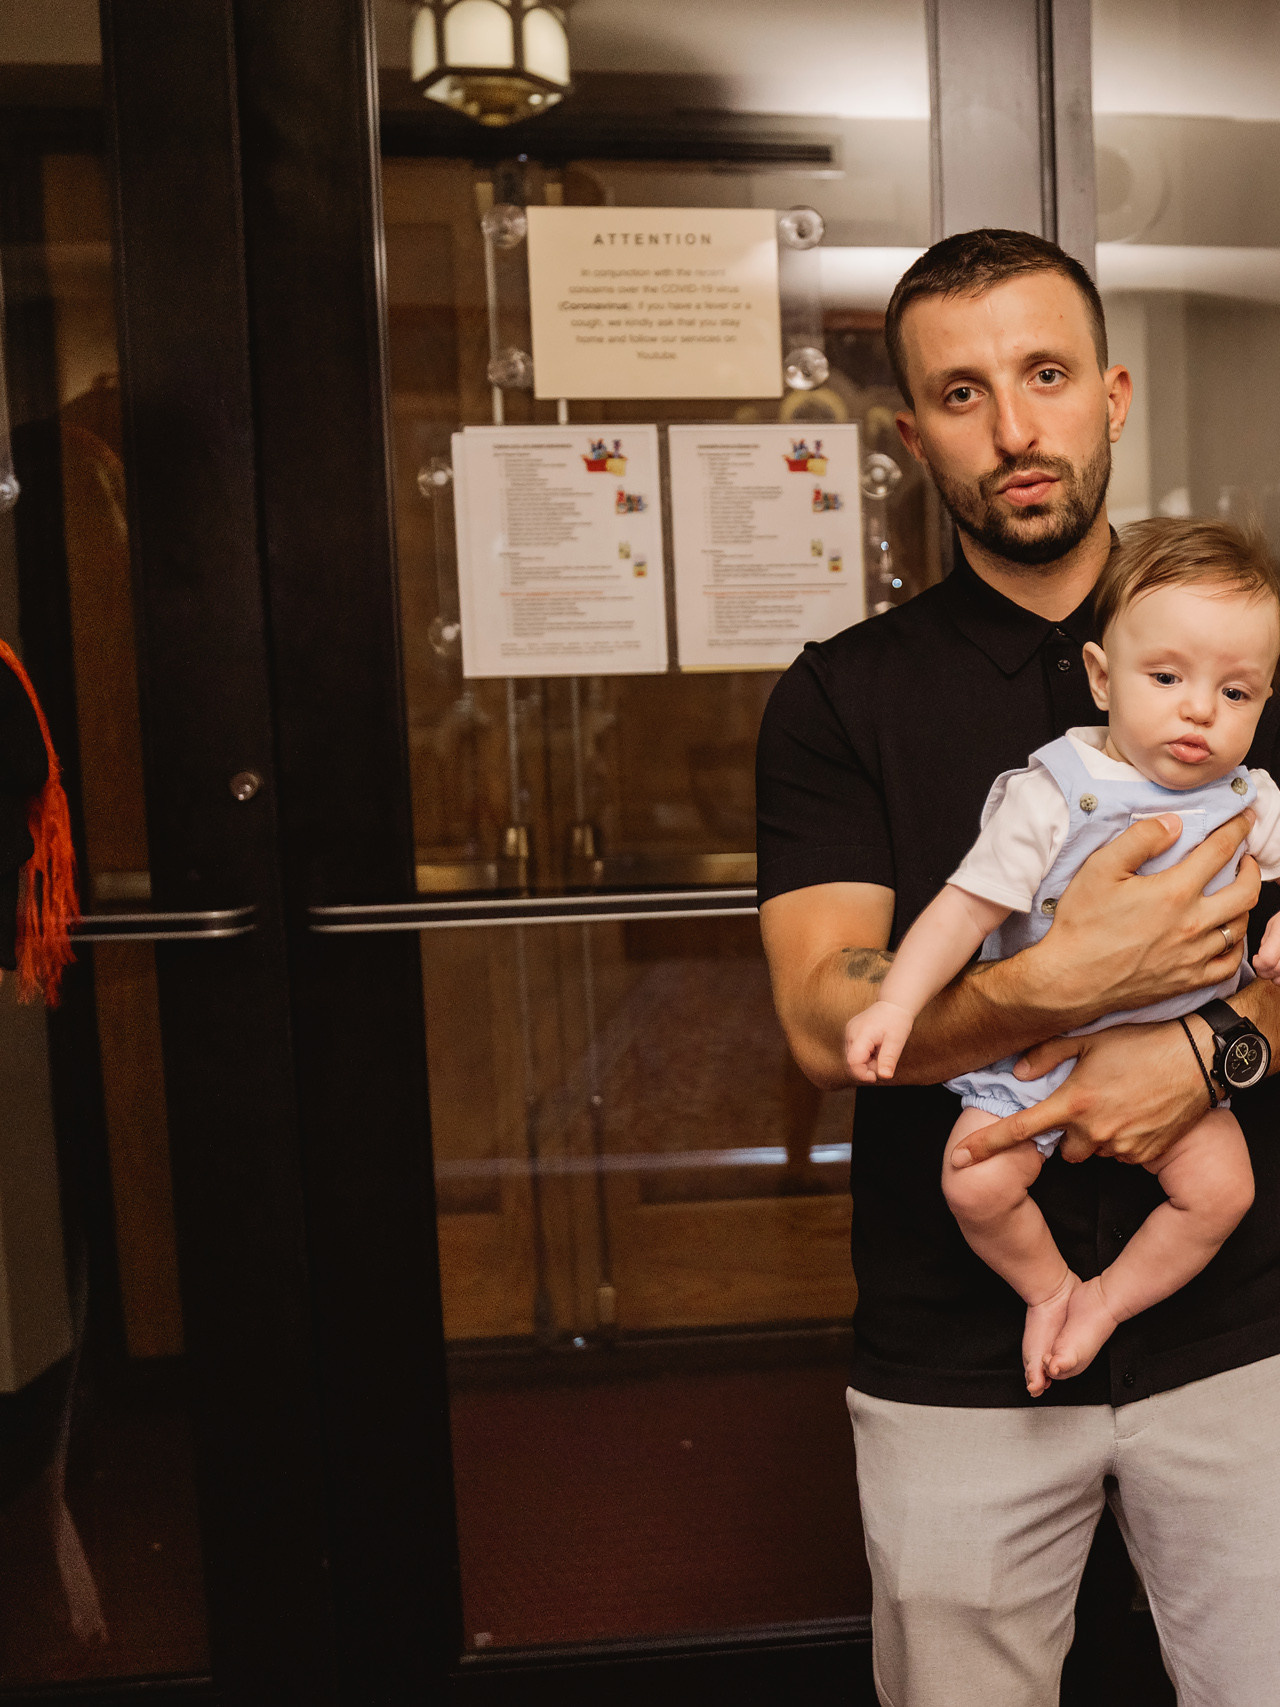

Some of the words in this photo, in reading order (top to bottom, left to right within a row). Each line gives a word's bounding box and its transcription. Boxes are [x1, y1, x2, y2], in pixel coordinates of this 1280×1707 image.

[593, 233, 712, 245] ATTENTION
[593, 268, 649, 279] conjunction
[654, 268, 673, 276] with
[676, 268, 691, 276] the
[642, 285, 658, 293] the
[660, 284, 713, 293] COVID-19
[647, 303, 665, 312] you
[668, 301, 693, 310] have
[657, 318, 674, 326] ask
[677, 317, 696, 326] that
[699, 319, 717, 328] you
[607, 334, 627, 343] and
